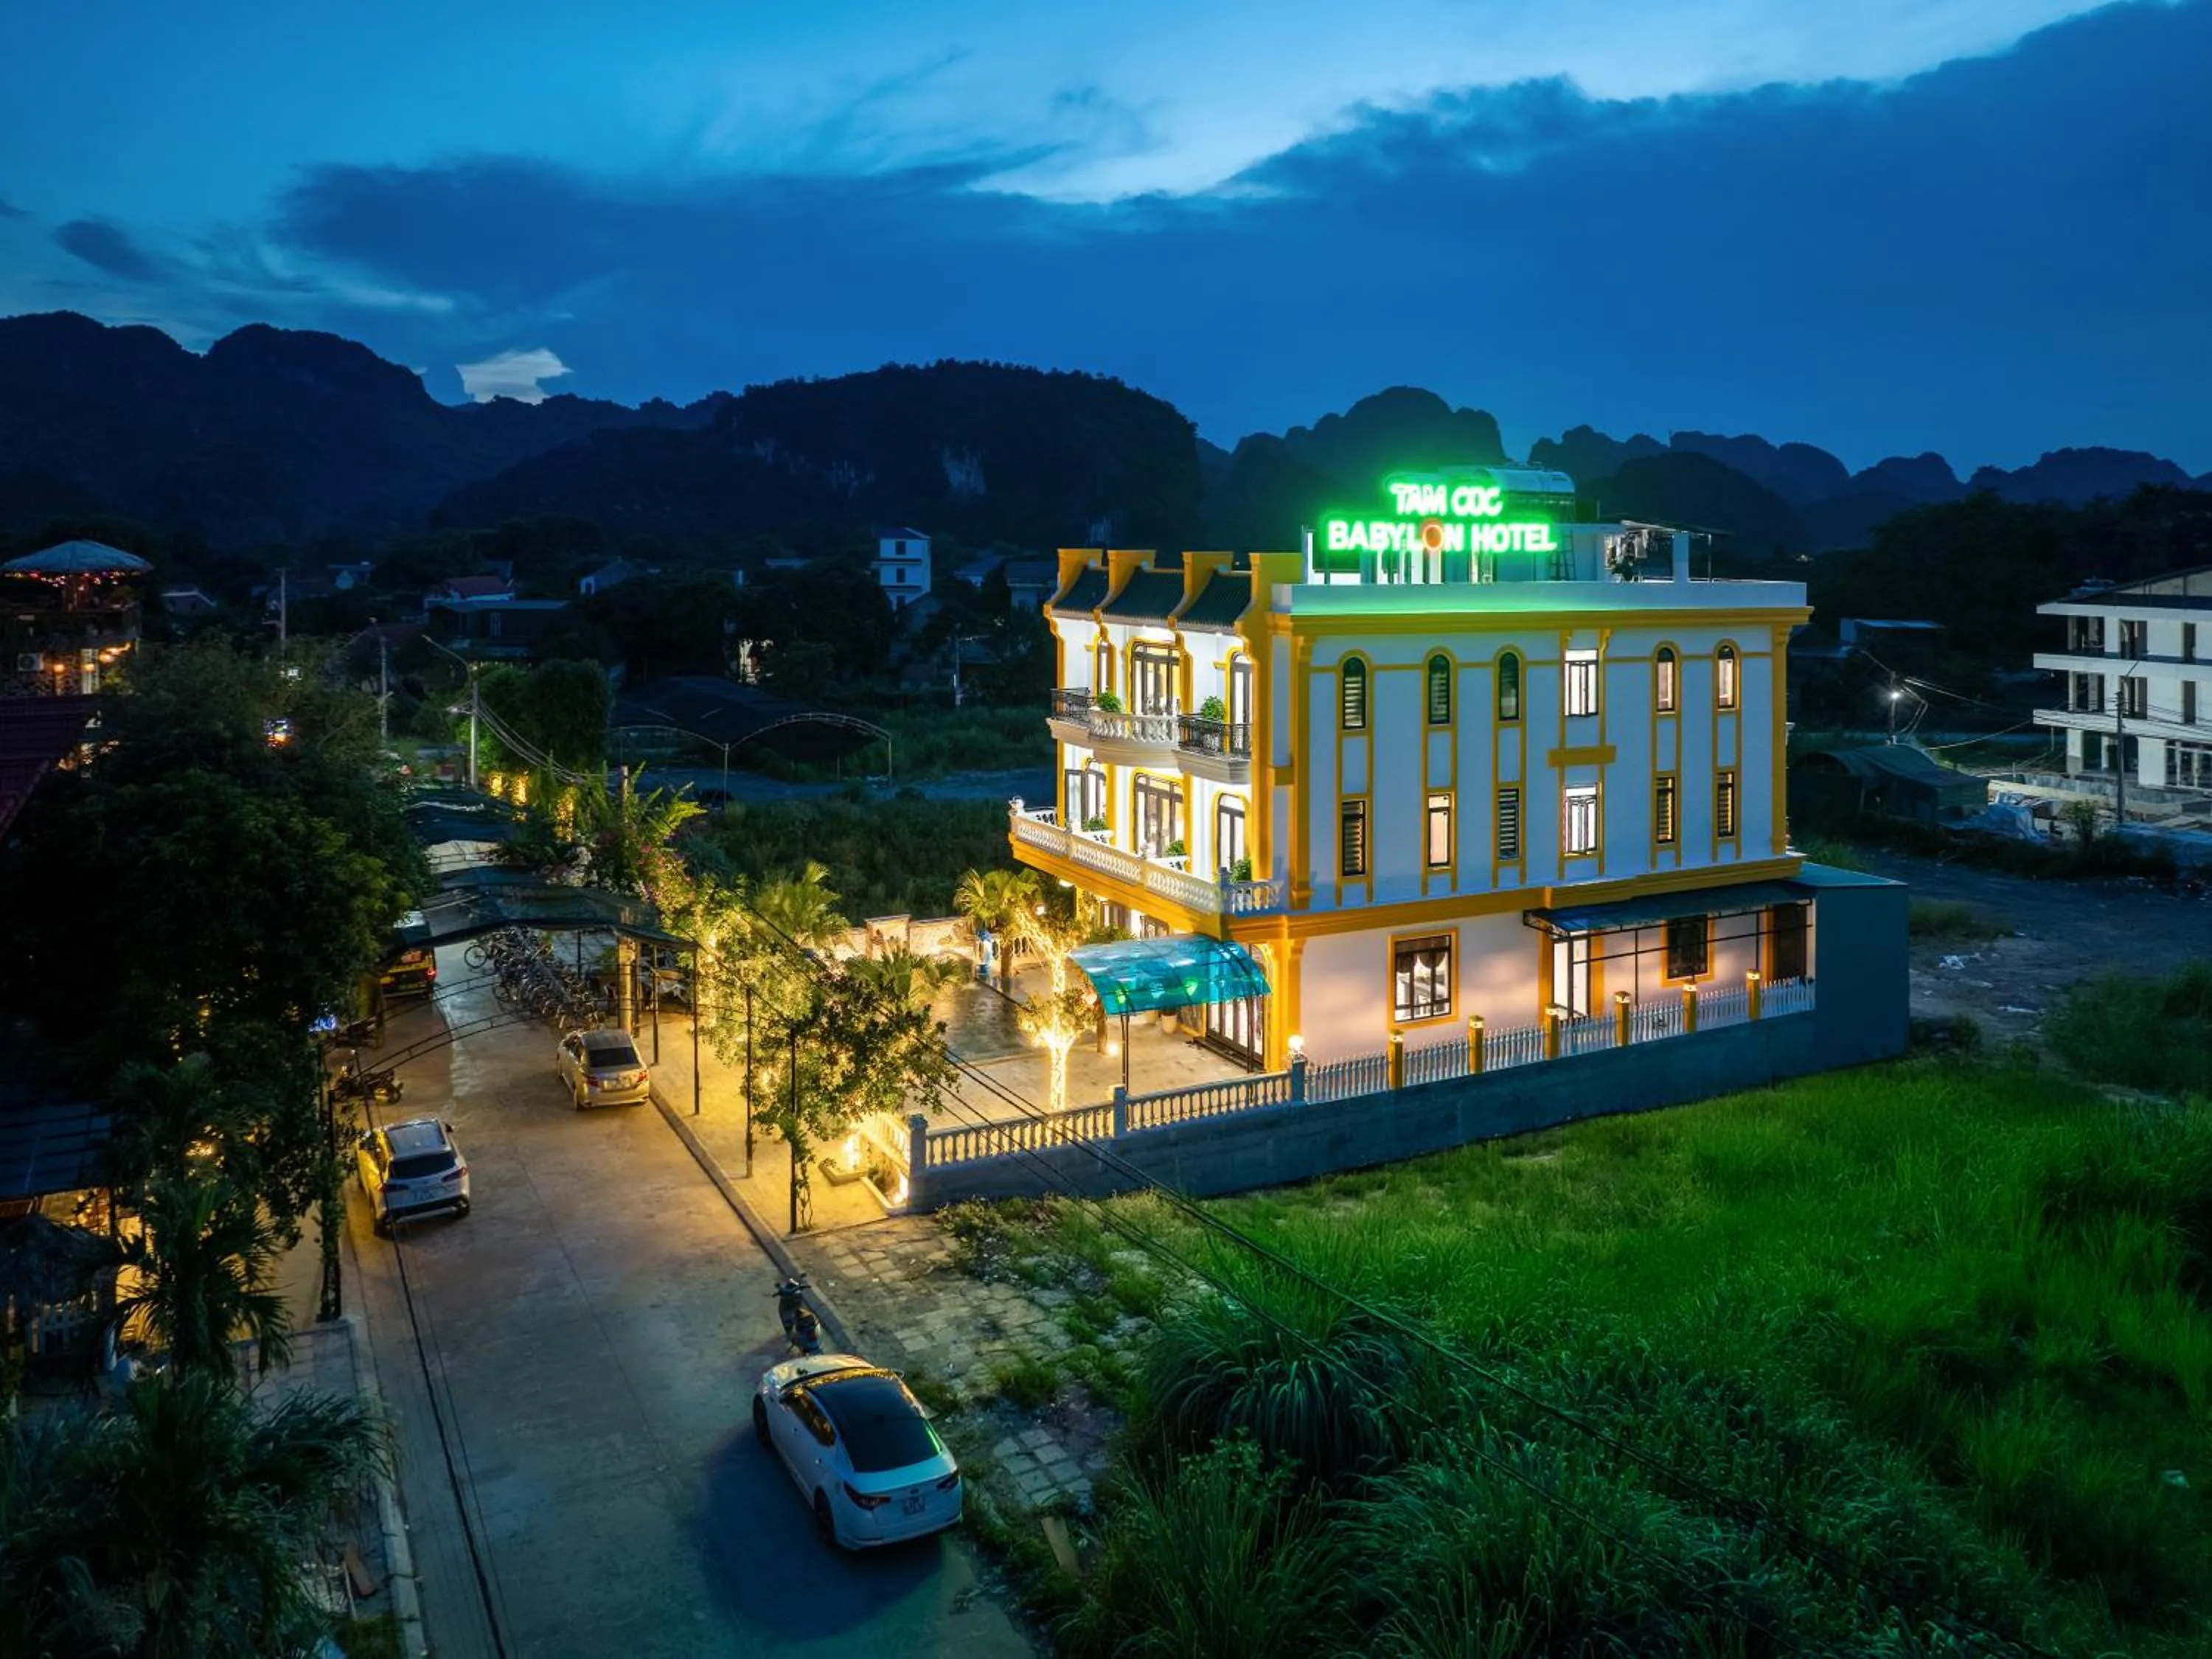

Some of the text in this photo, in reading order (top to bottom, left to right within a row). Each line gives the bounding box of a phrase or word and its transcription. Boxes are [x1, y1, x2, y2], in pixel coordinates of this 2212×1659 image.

[1390, 483, 1447, 515] TAM
[1328, 521, 1558, 553] BABYLON HOTEL
